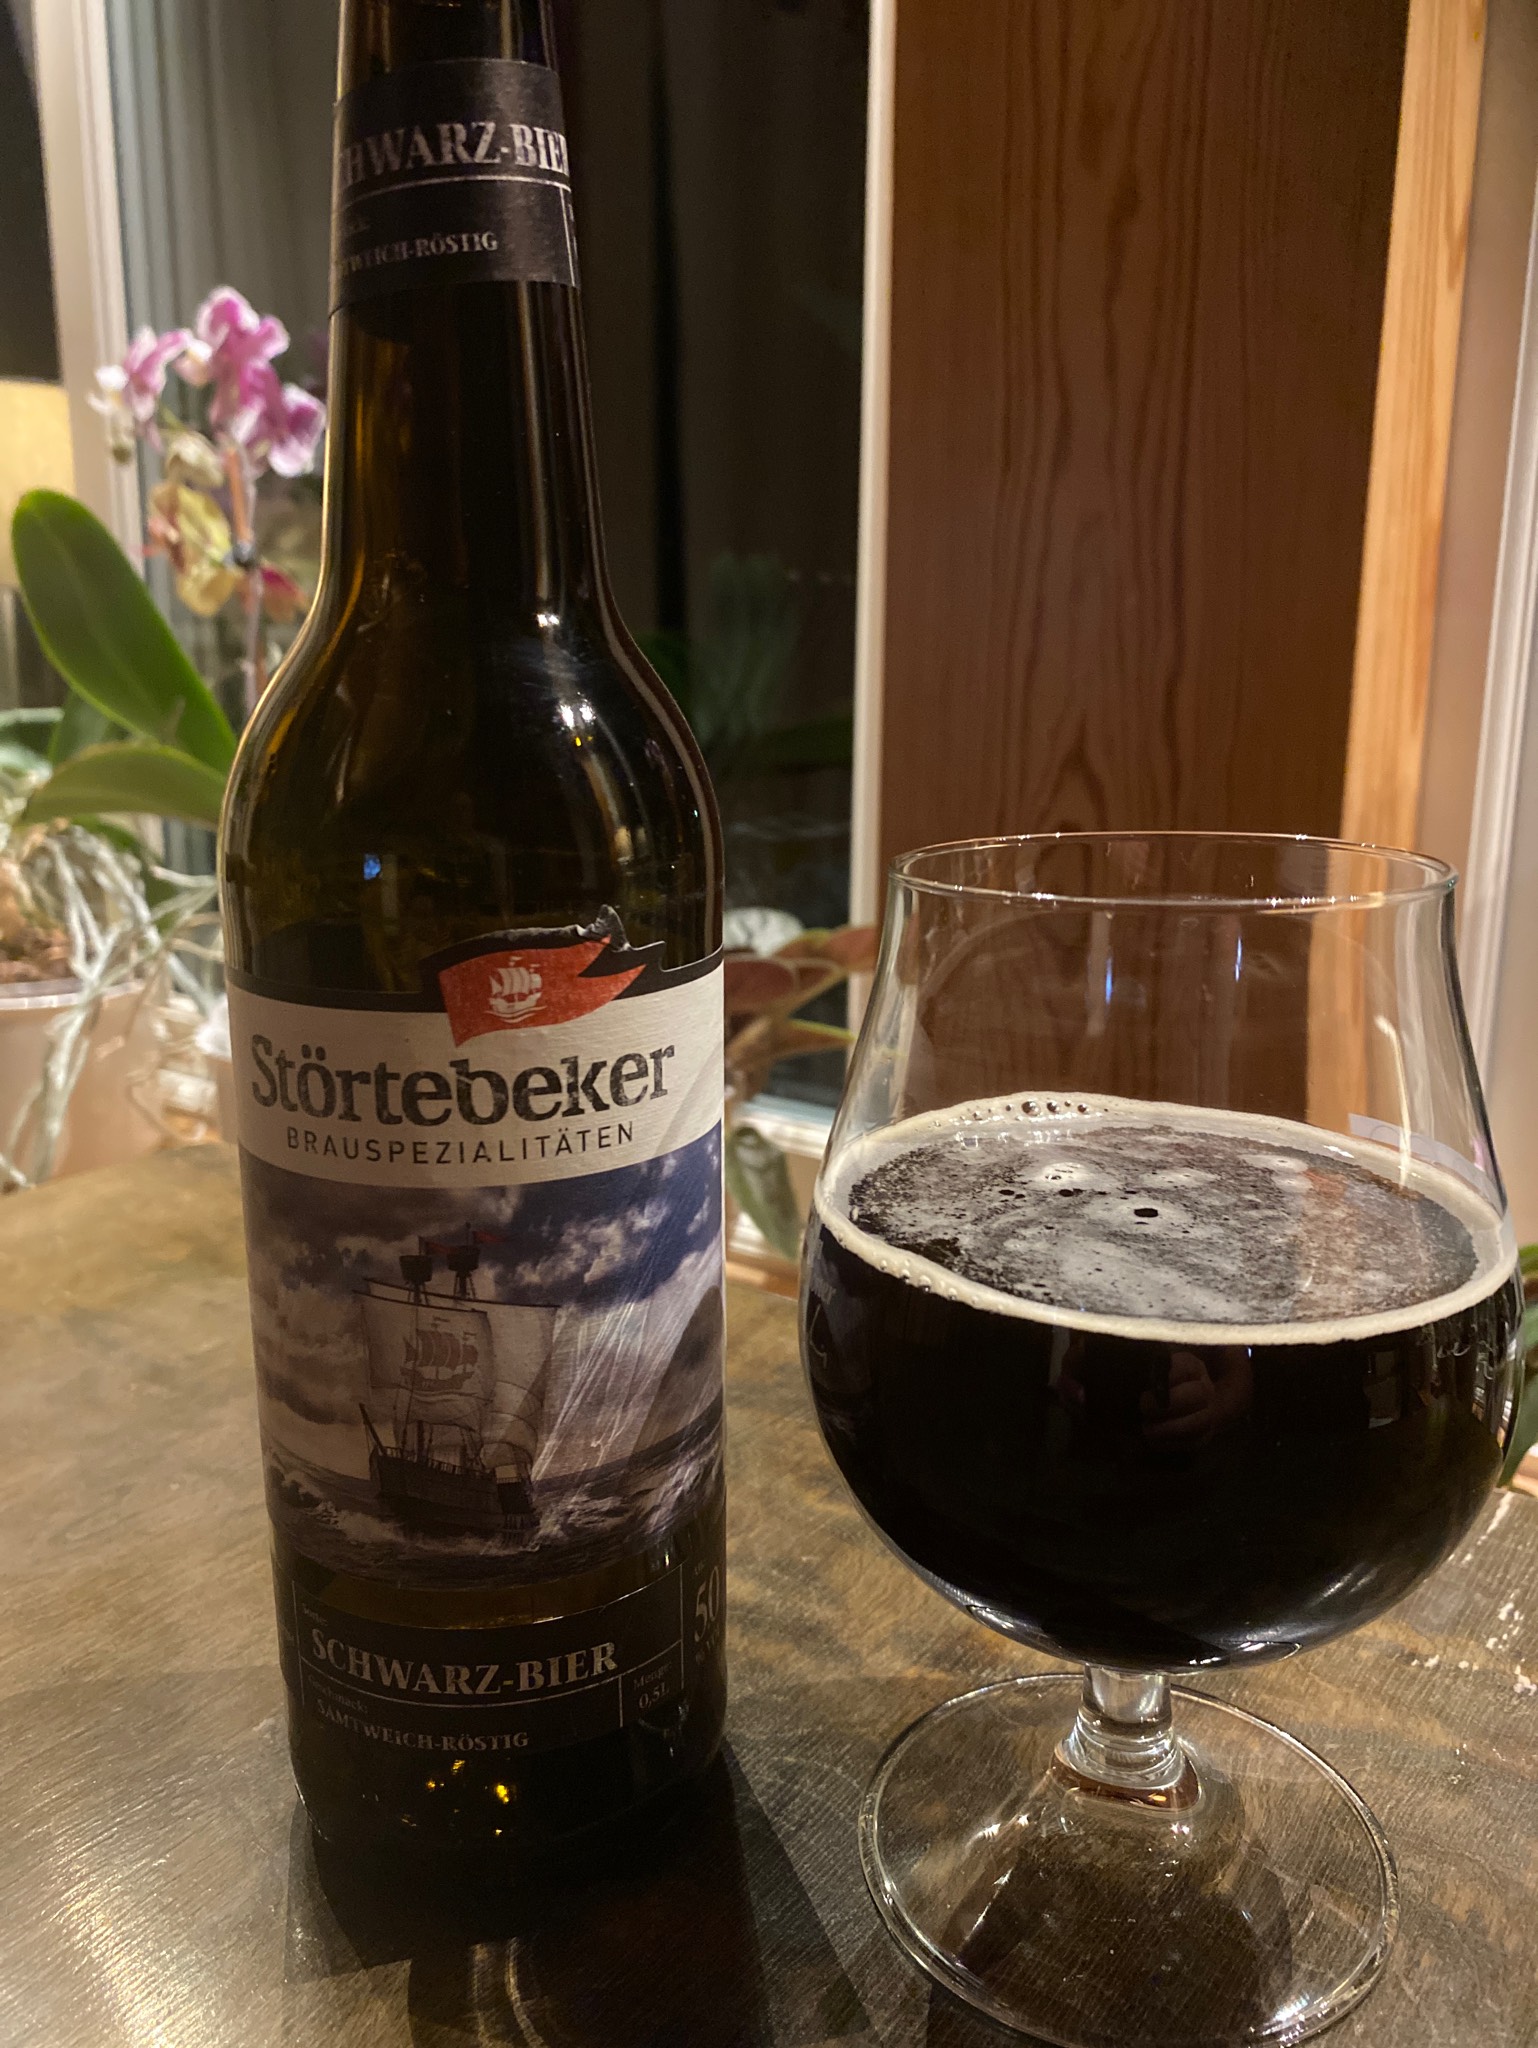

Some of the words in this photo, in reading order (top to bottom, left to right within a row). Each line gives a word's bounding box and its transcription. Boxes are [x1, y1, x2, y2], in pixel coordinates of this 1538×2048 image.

[251, 1033, 675, 1127] Störtebeker
[286, 1120, 634, 1165] BRAUSPEZIALITÄTEN
[311, 1628, 618, 1695] SCHWARZ-BIER
[317, 1698, 530, 1752] SAMTWEICH-RÖSTIG
